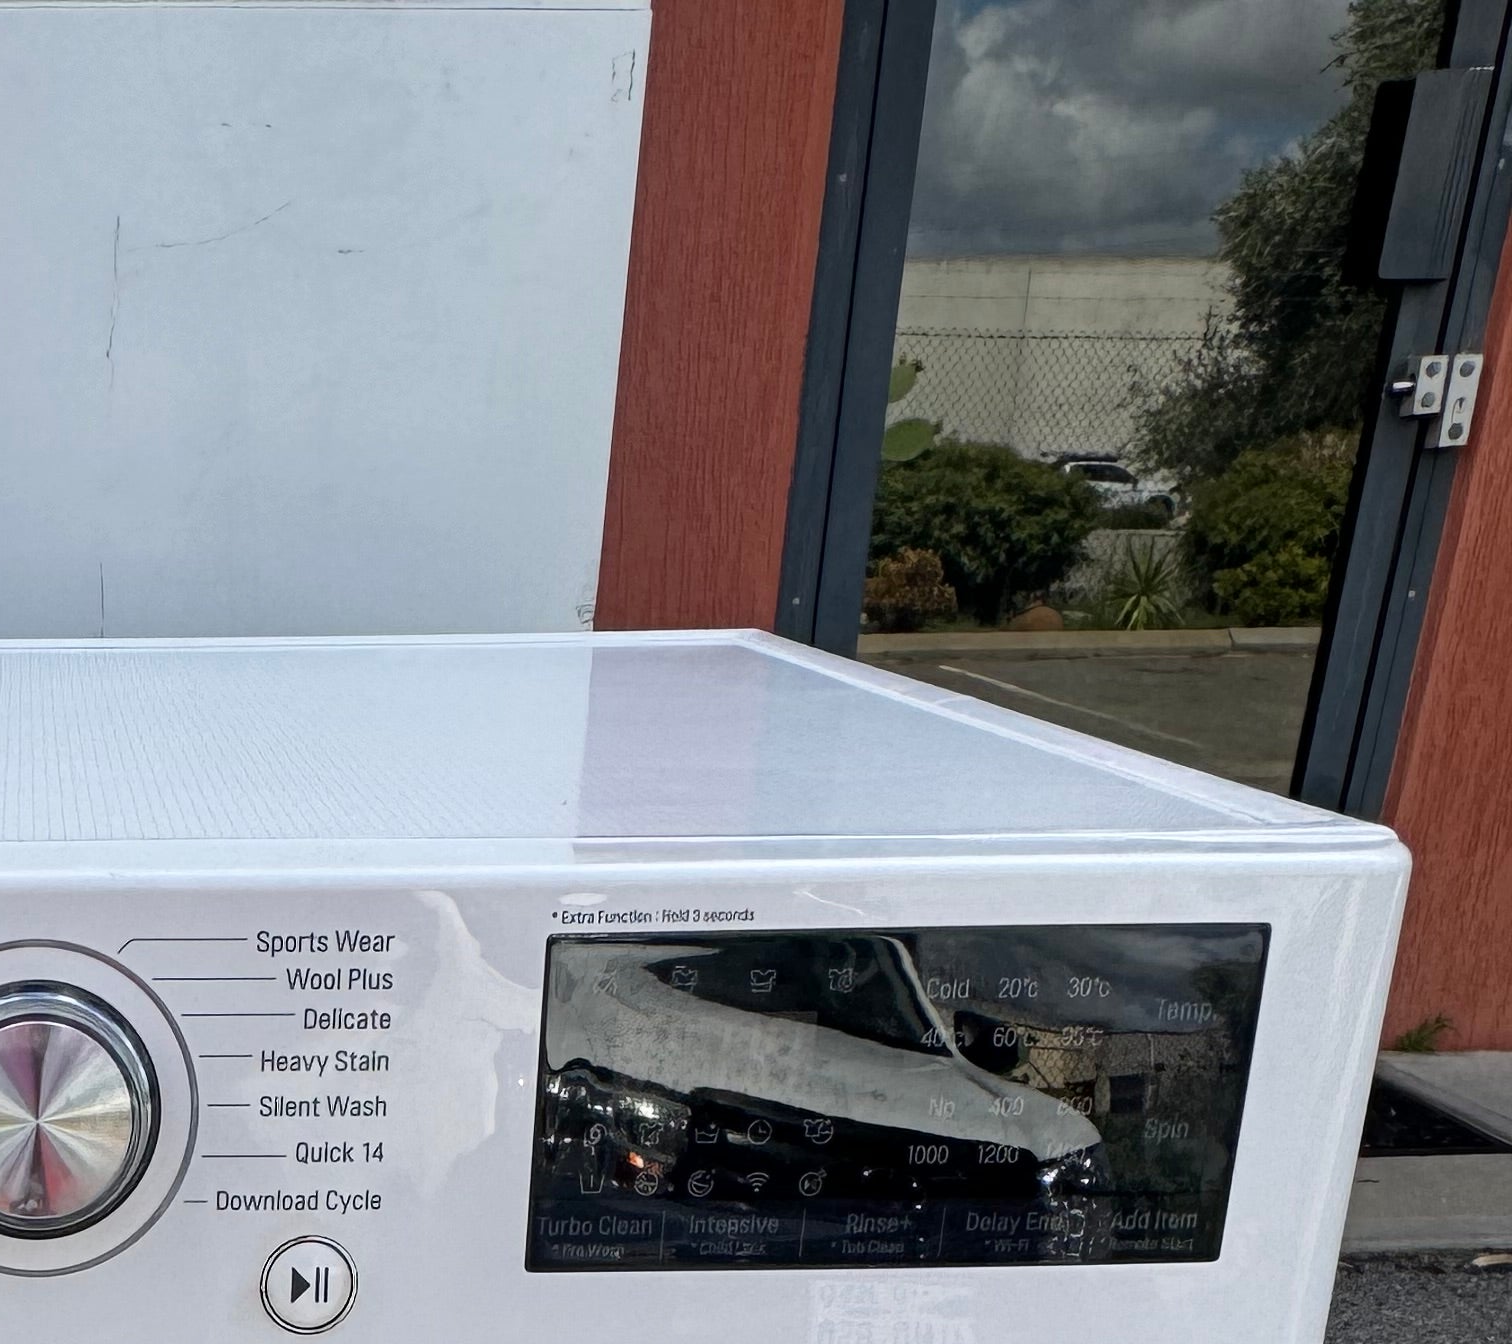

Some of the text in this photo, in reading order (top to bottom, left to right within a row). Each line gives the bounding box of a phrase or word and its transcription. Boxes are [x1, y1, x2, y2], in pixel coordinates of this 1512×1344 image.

[256, 931, 396, 957] Sports Wear
[287, 968, 393, 991] Wool Plus
[926, 977, 970, 1000] Cold
[304, 1008, 392, 1031] Delicate
[260, 1050, 390, 1076] Heavy Stain
[259, 1096, 388, 1117] Silent Wash
[295, 1142, 385, 1165] Quick 14
[908, 1143, 1021, 1165] 1000 1200
[216, 1190, 383, 1215] Download Cycle
[536, 1215, 653, 1236] Turbo Clean
[688, 1215, 780, 1235] Intensive
[966, 1211, 1022, 1235] Delay
[1110, 1208, 1152, 1231] Add
